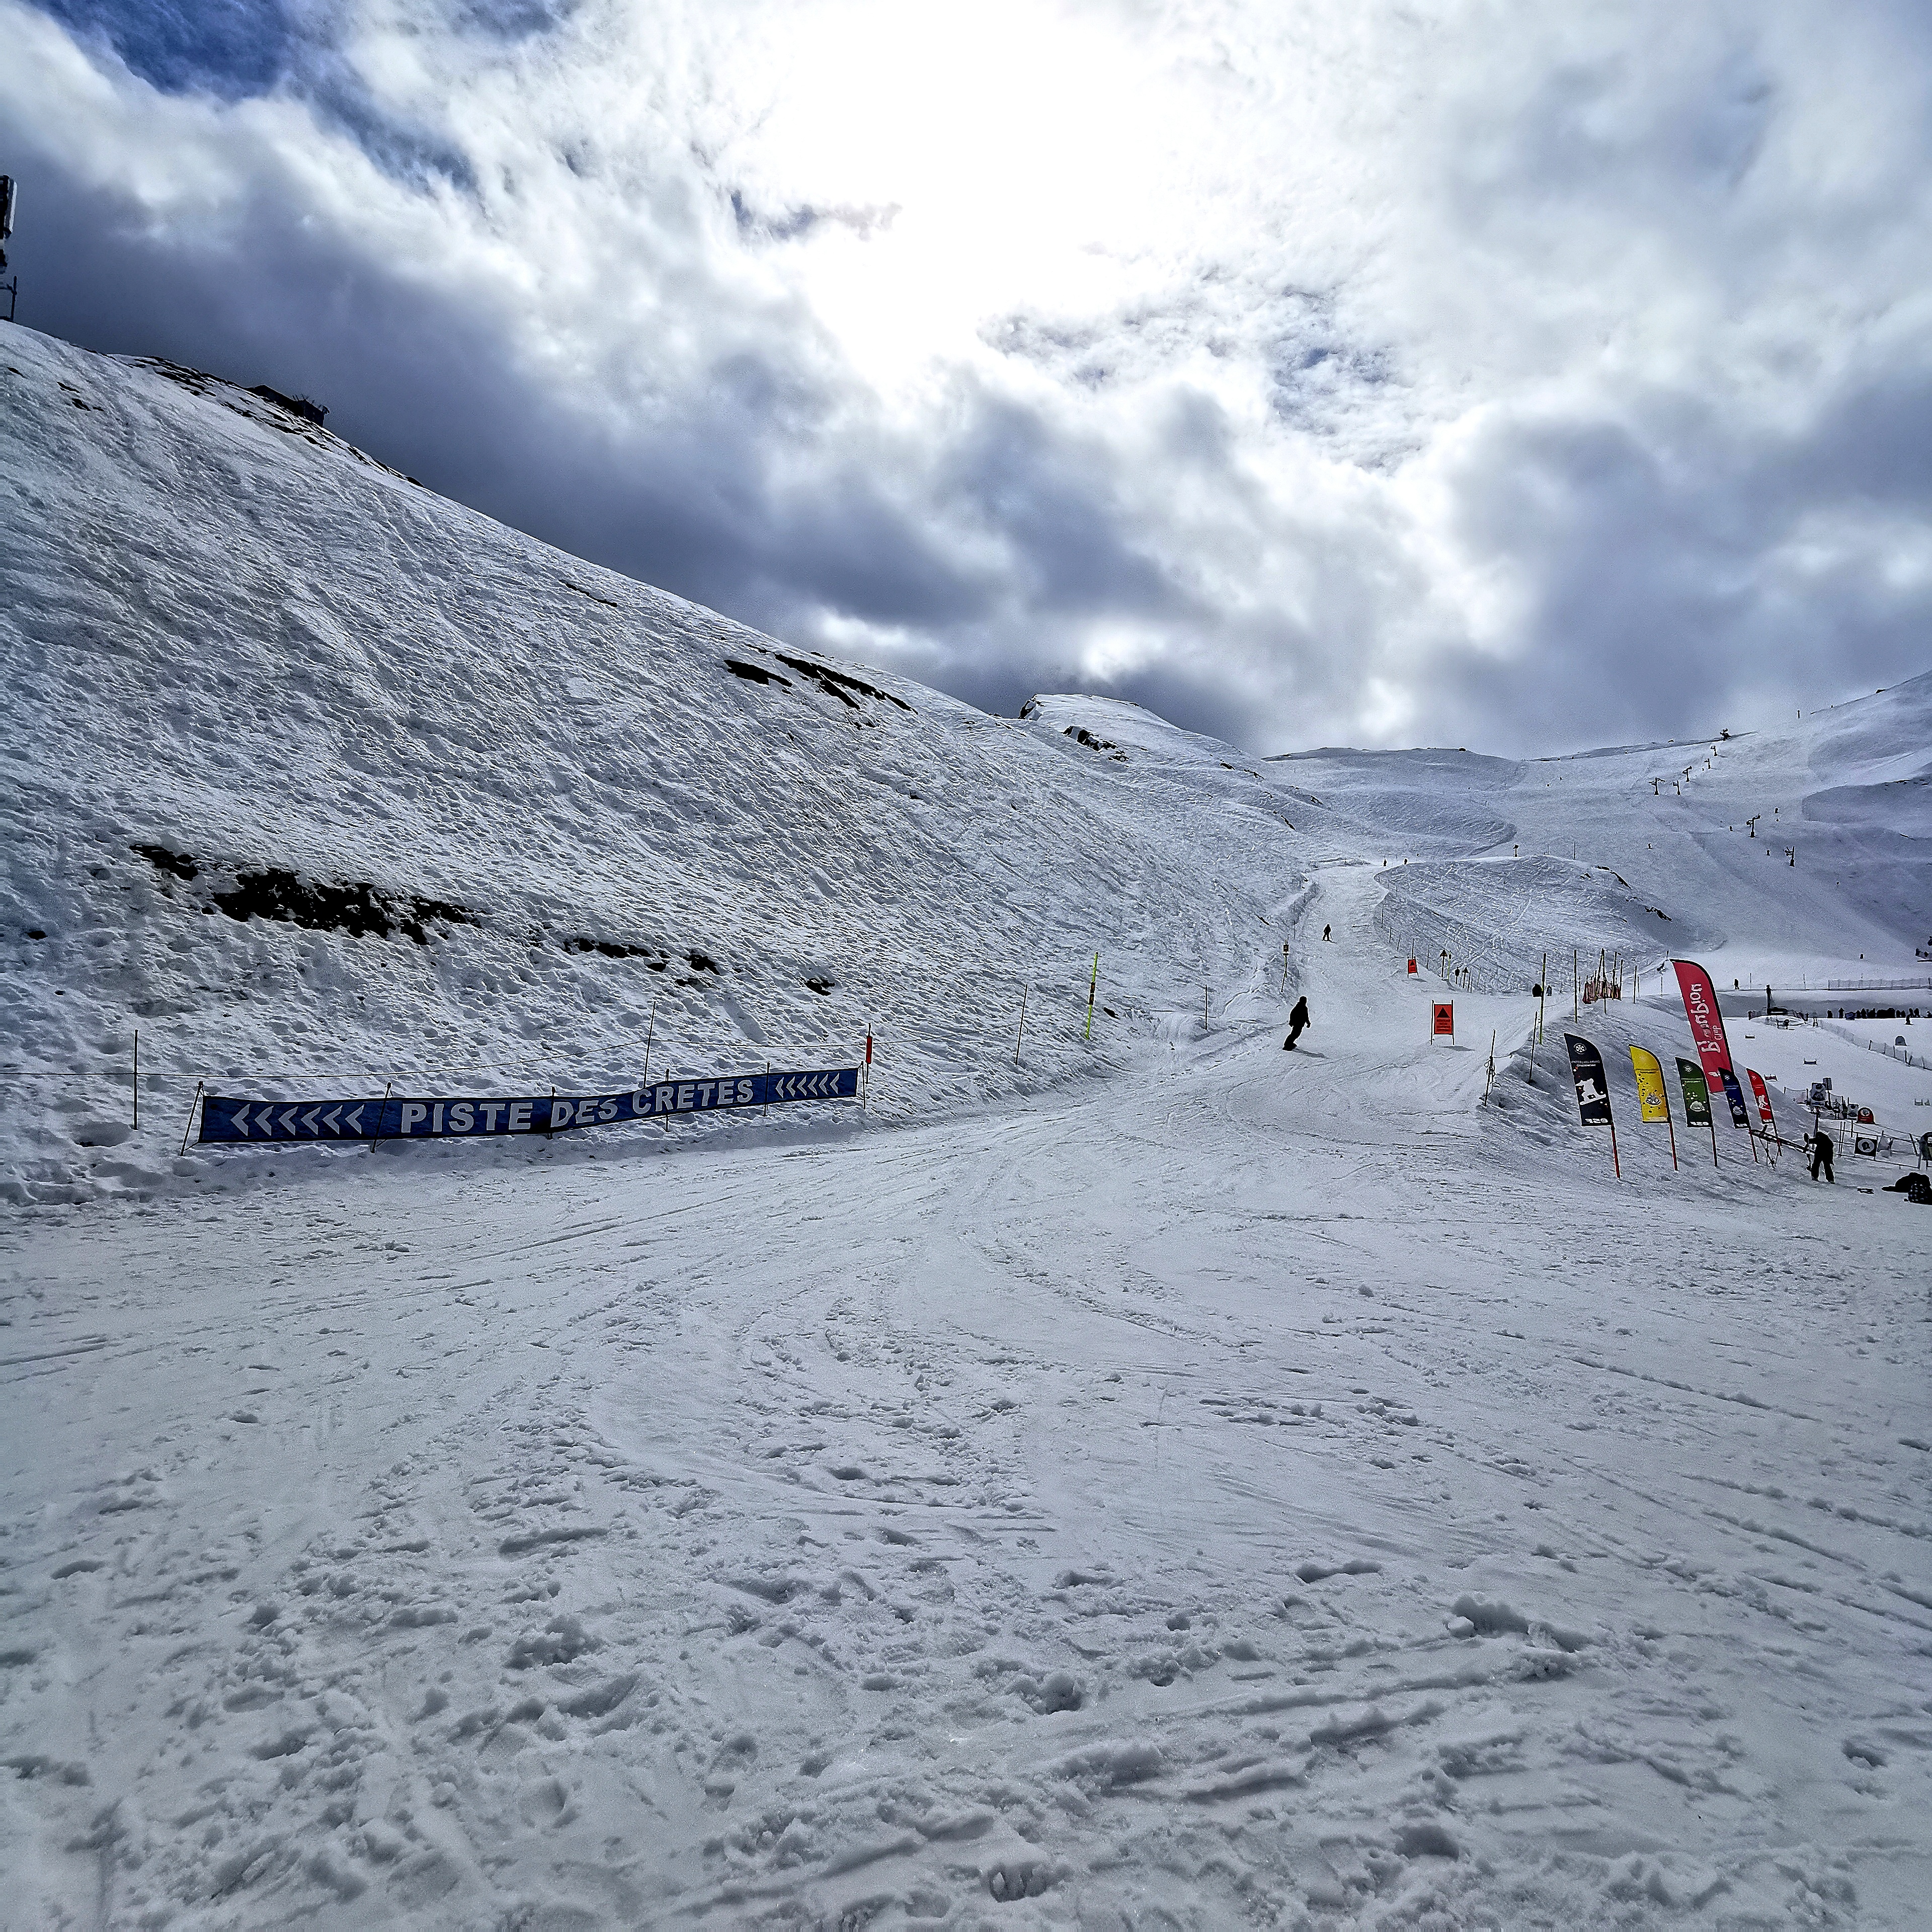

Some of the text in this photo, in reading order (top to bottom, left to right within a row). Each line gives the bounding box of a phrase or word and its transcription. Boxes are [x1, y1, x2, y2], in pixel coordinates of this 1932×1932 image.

[401, 1079, 754, 1133] PISTE DES CRETES
